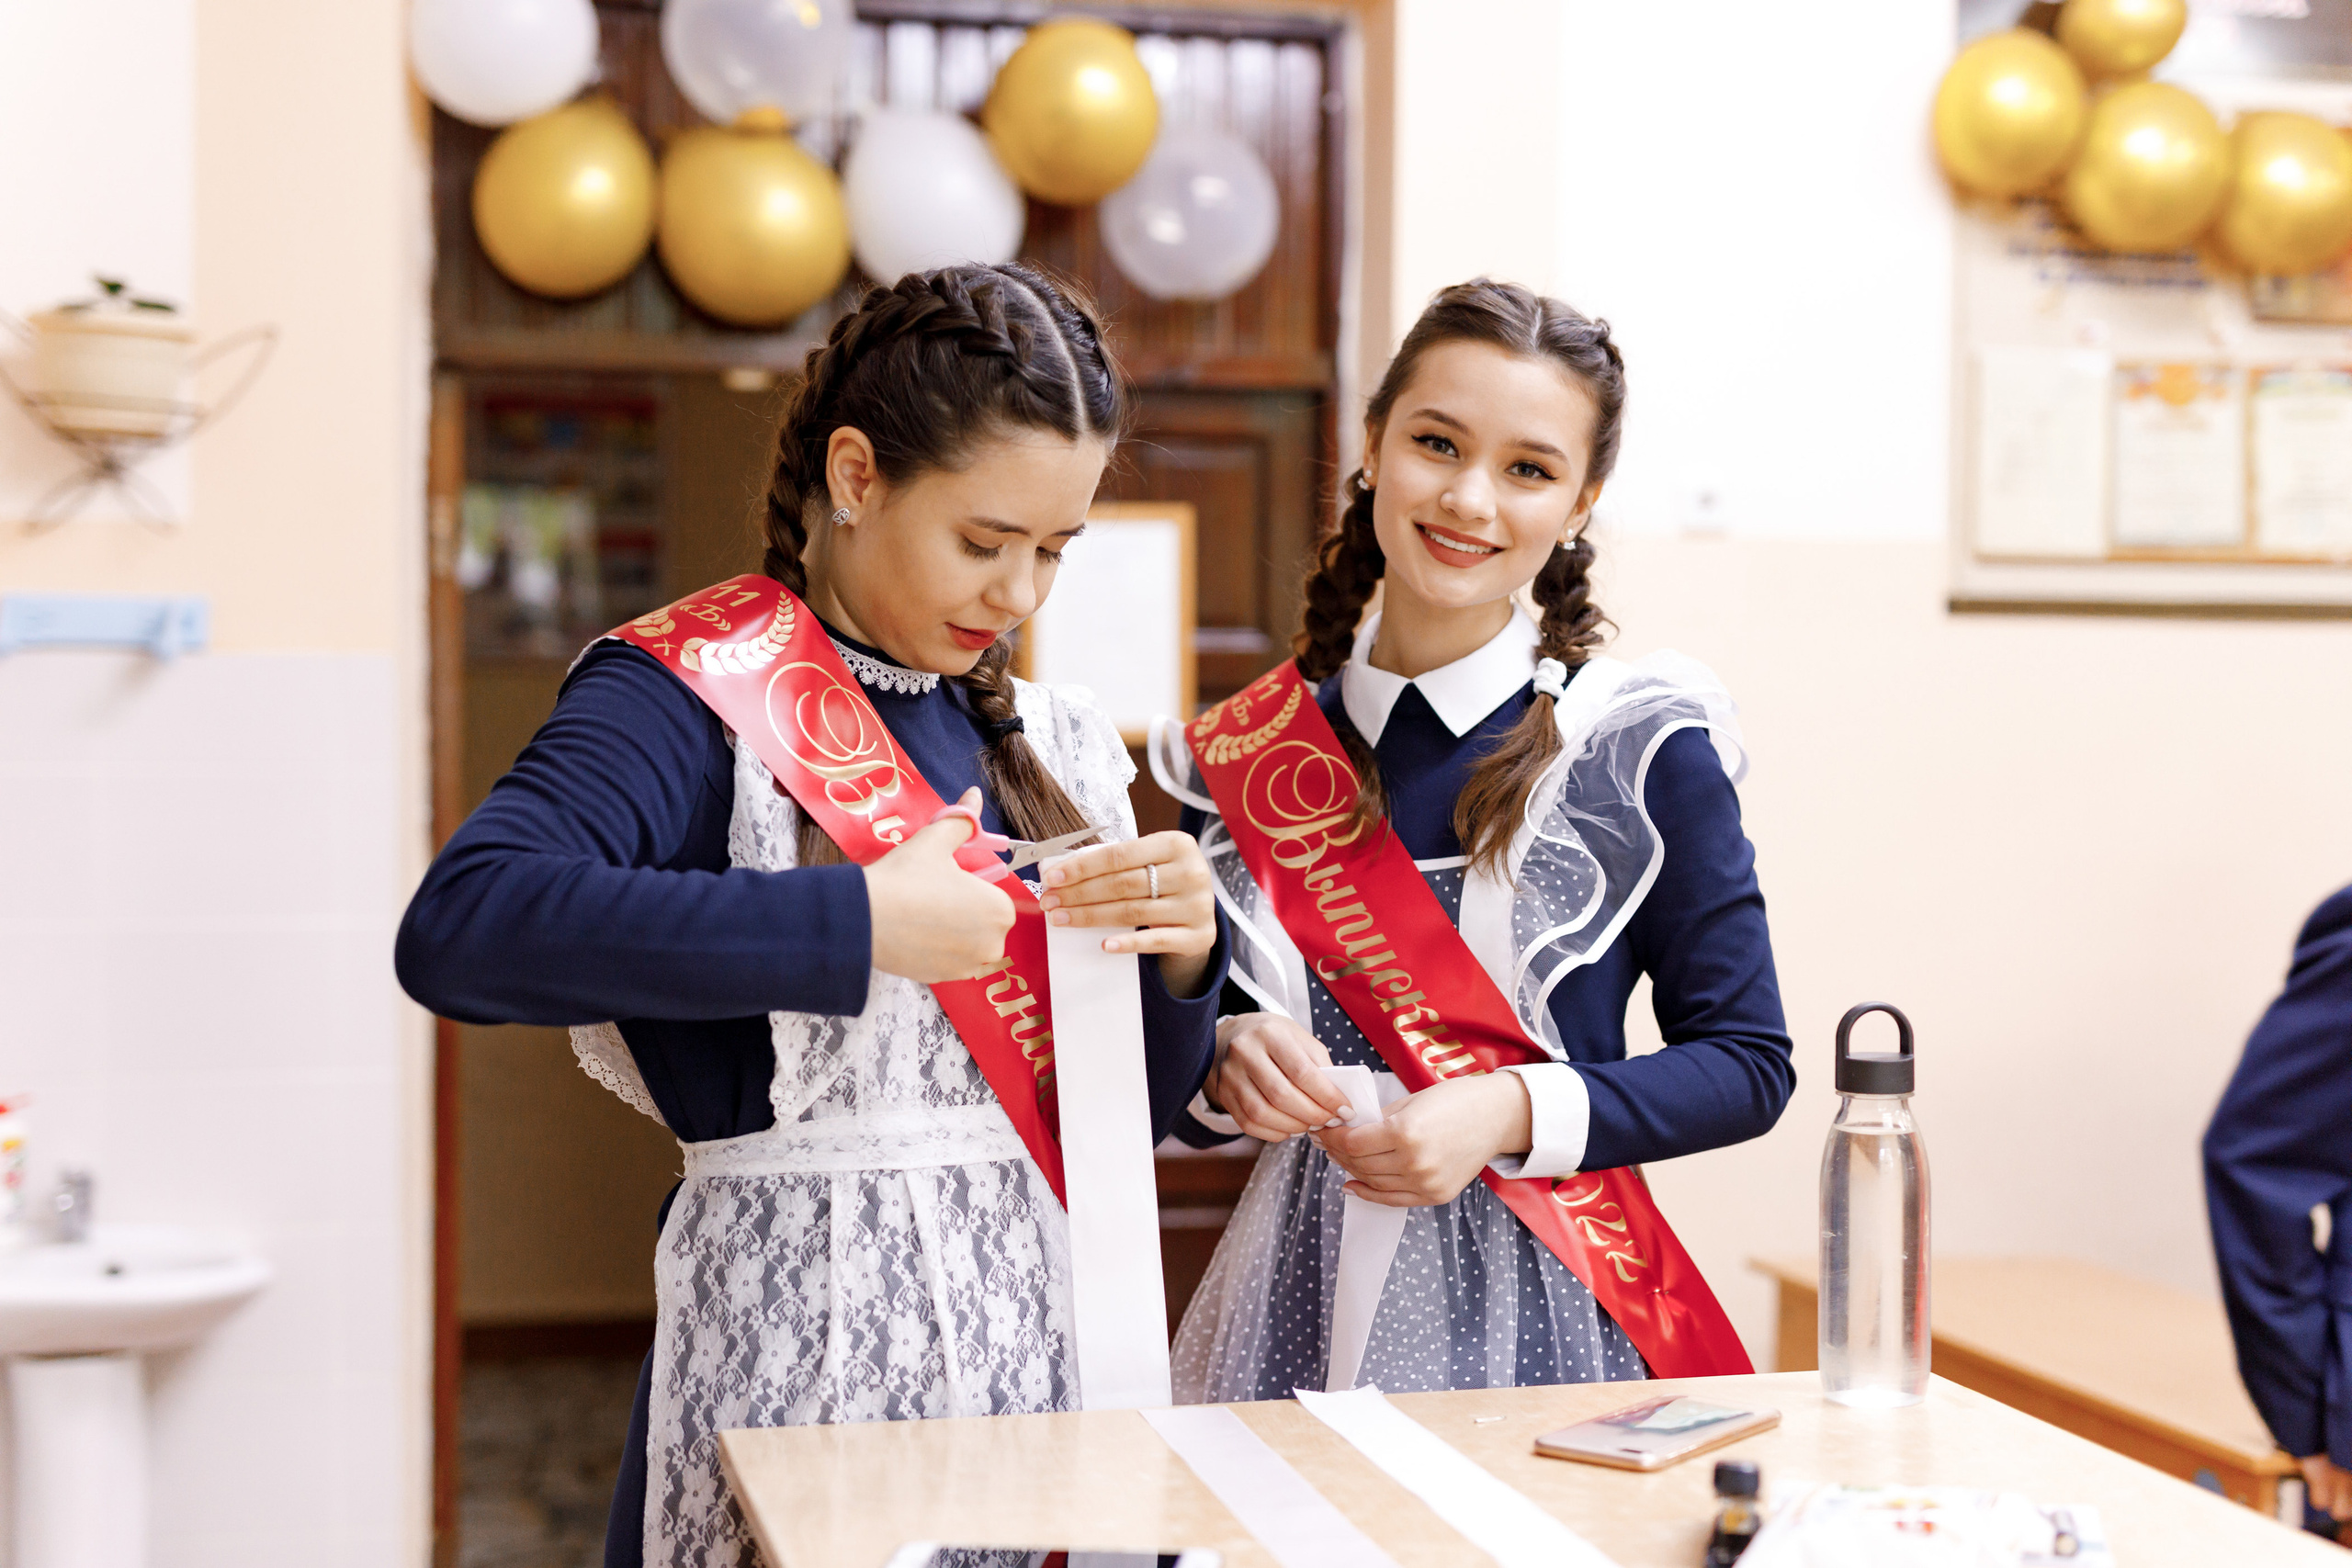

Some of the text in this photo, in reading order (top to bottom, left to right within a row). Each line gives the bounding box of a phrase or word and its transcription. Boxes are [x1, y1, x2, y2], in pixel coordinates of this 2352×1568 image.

[710, 584, 761, 607] 11
[1254, 673, 1283, 702] 11
[1242, 739, 1648, 1283] Выпускни 022
